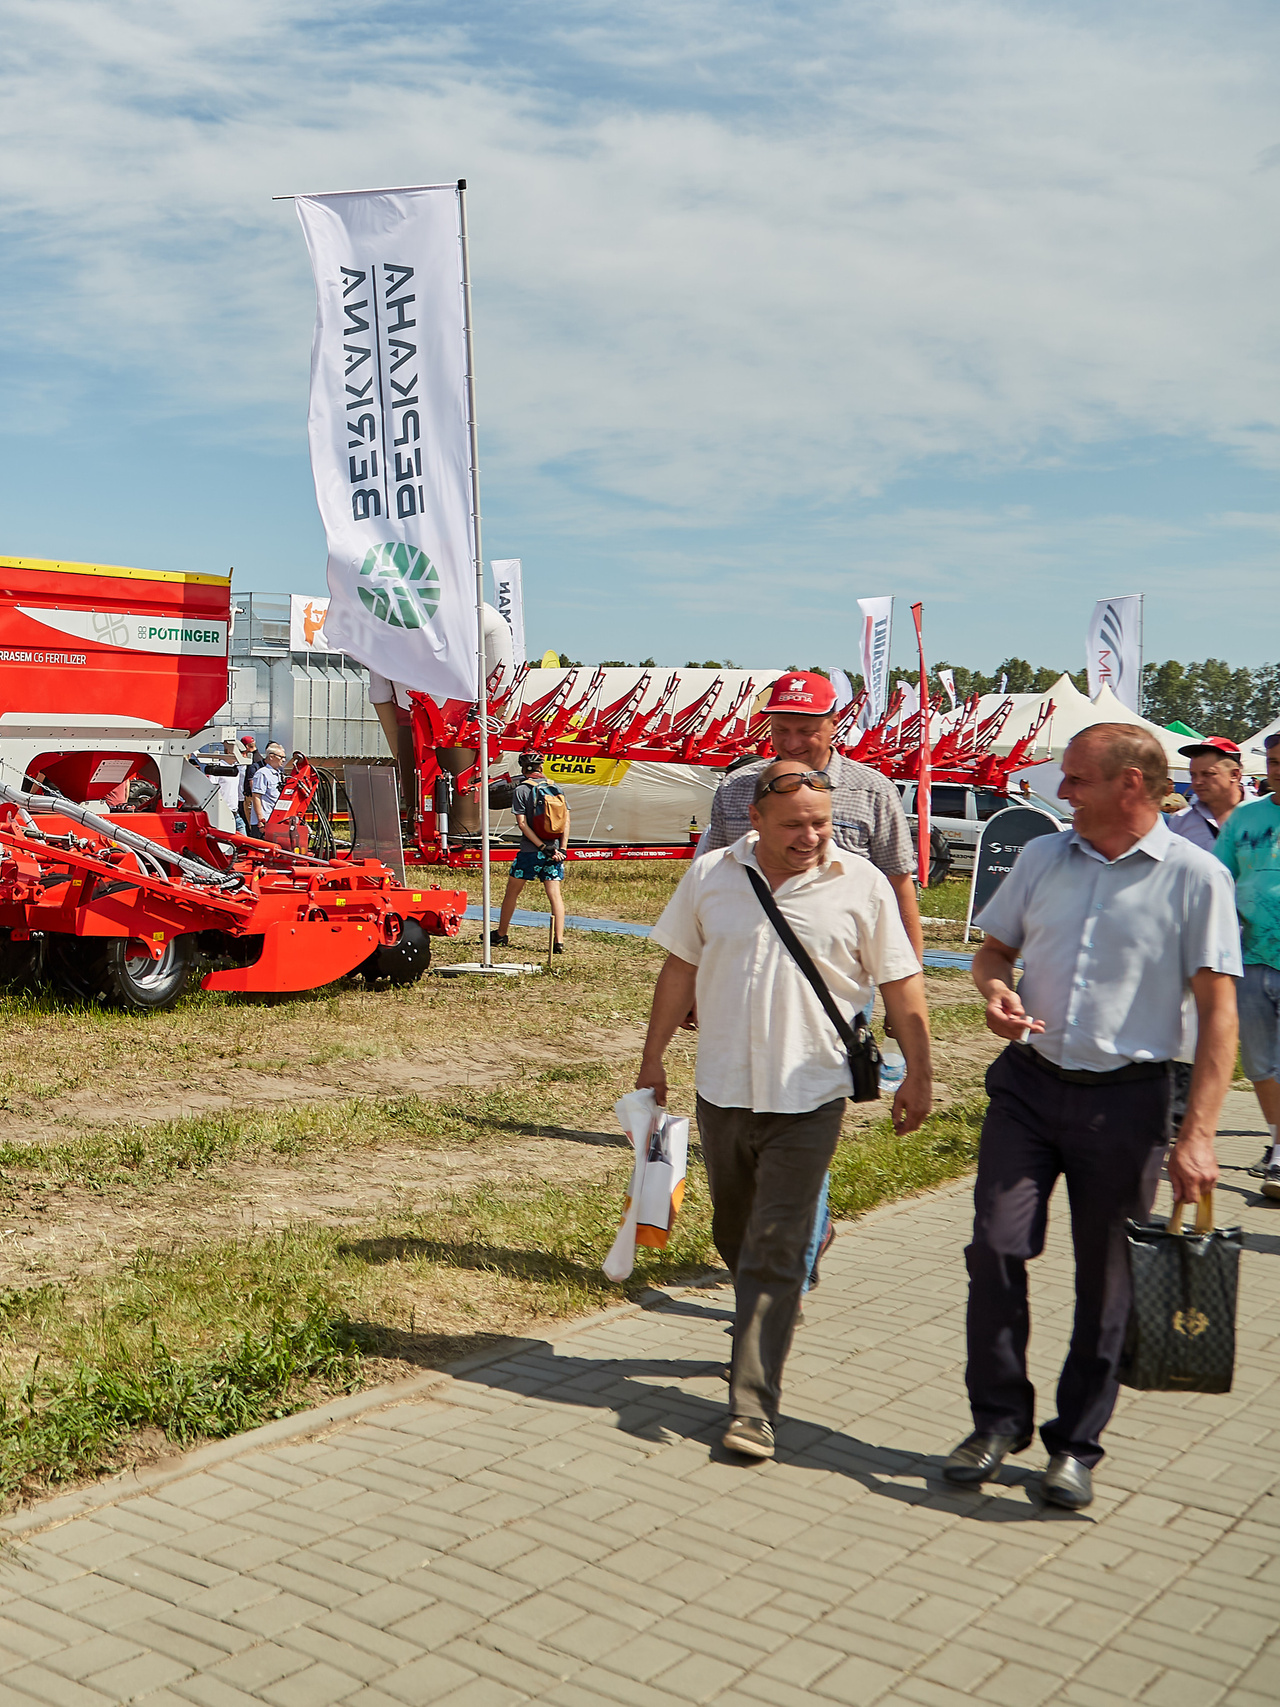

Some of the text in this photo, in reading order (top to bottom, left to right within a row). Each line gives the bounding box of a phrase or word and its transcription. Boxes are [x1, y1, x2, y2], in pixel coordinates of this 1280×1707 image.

[33, 652, 44, 663] C6
[45, 652, 87, 665] FERTILIZER
[550, 763, 596, 774] СНАБ
[1004, 845, 1025, 854] STE
[987, 865, 1014, 874] АГРО
